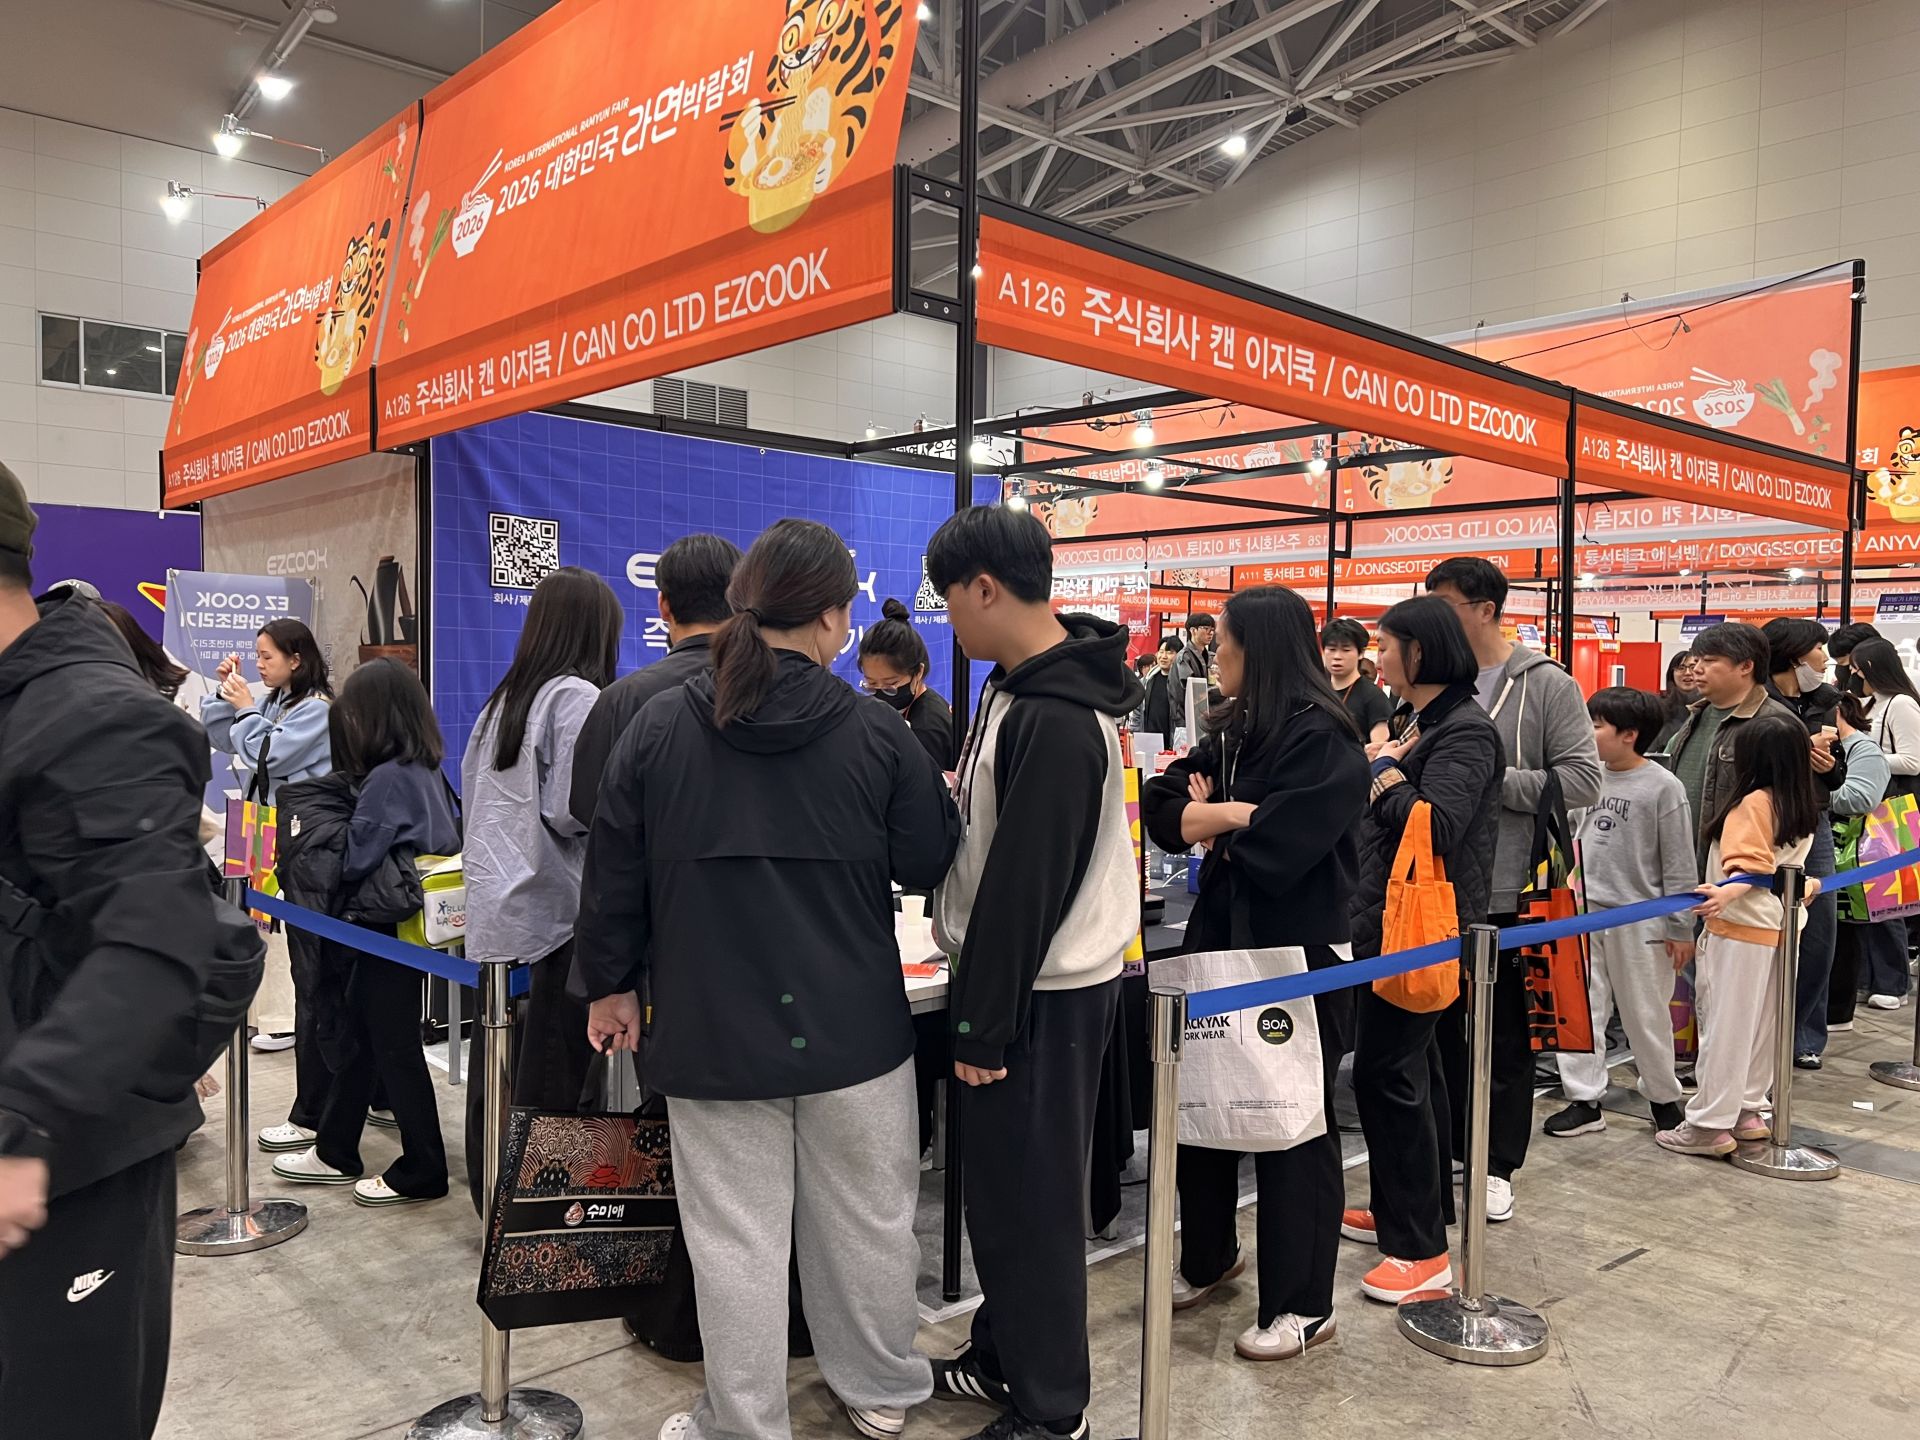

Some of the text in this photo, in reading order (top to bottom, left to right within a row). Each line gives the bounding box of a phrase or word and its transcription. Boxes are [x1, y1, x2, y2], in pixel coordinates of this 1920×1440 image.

[504, 97, 629, 172] KOREA INTERNATIONAL RAMYUN FAIR
[496, 169, 540, 215] 2026
[544, 125, 619, 190] 대한민국
[455, 211, 484, 242] 2026
[226, 328, 246, 354] 2026
[385, 247, 831, 419] A126 주식회사 캔 이지쿡 / CAN CO LTD EZCOOK
[999, 272, 1538, 446] A126 주식회사 캔 이지쿡 / CAN CO LTD EZCOOK
[168, 473, 181, 487] A126
[182, 459, 210, 488] 주식회사
[212, 453, 220, 478] 캔
[221, 444, 244, 473] 이지쿡
[252, 437, 271, 465] CAN
[272, 431, 286, 458] CO
[288, 425, 305, 453] LTD
[307, 409, 351, 447] EZCOOK
[1582, 436, 1832, 511] A126 주식회사 캔 이지쿡 / CAN CO LTD EZCOOK
[1239, 571, 1259, 580] A111
[1263, 567, 1305, 582] 동서테크
[1201, 1030, 1226, 1040] WEAR
[1262, 1019, 1289, 1031] BOA
[586, 1204, 625, 1220] 수미애
[73, 1269, 104, 1292] NIKE
